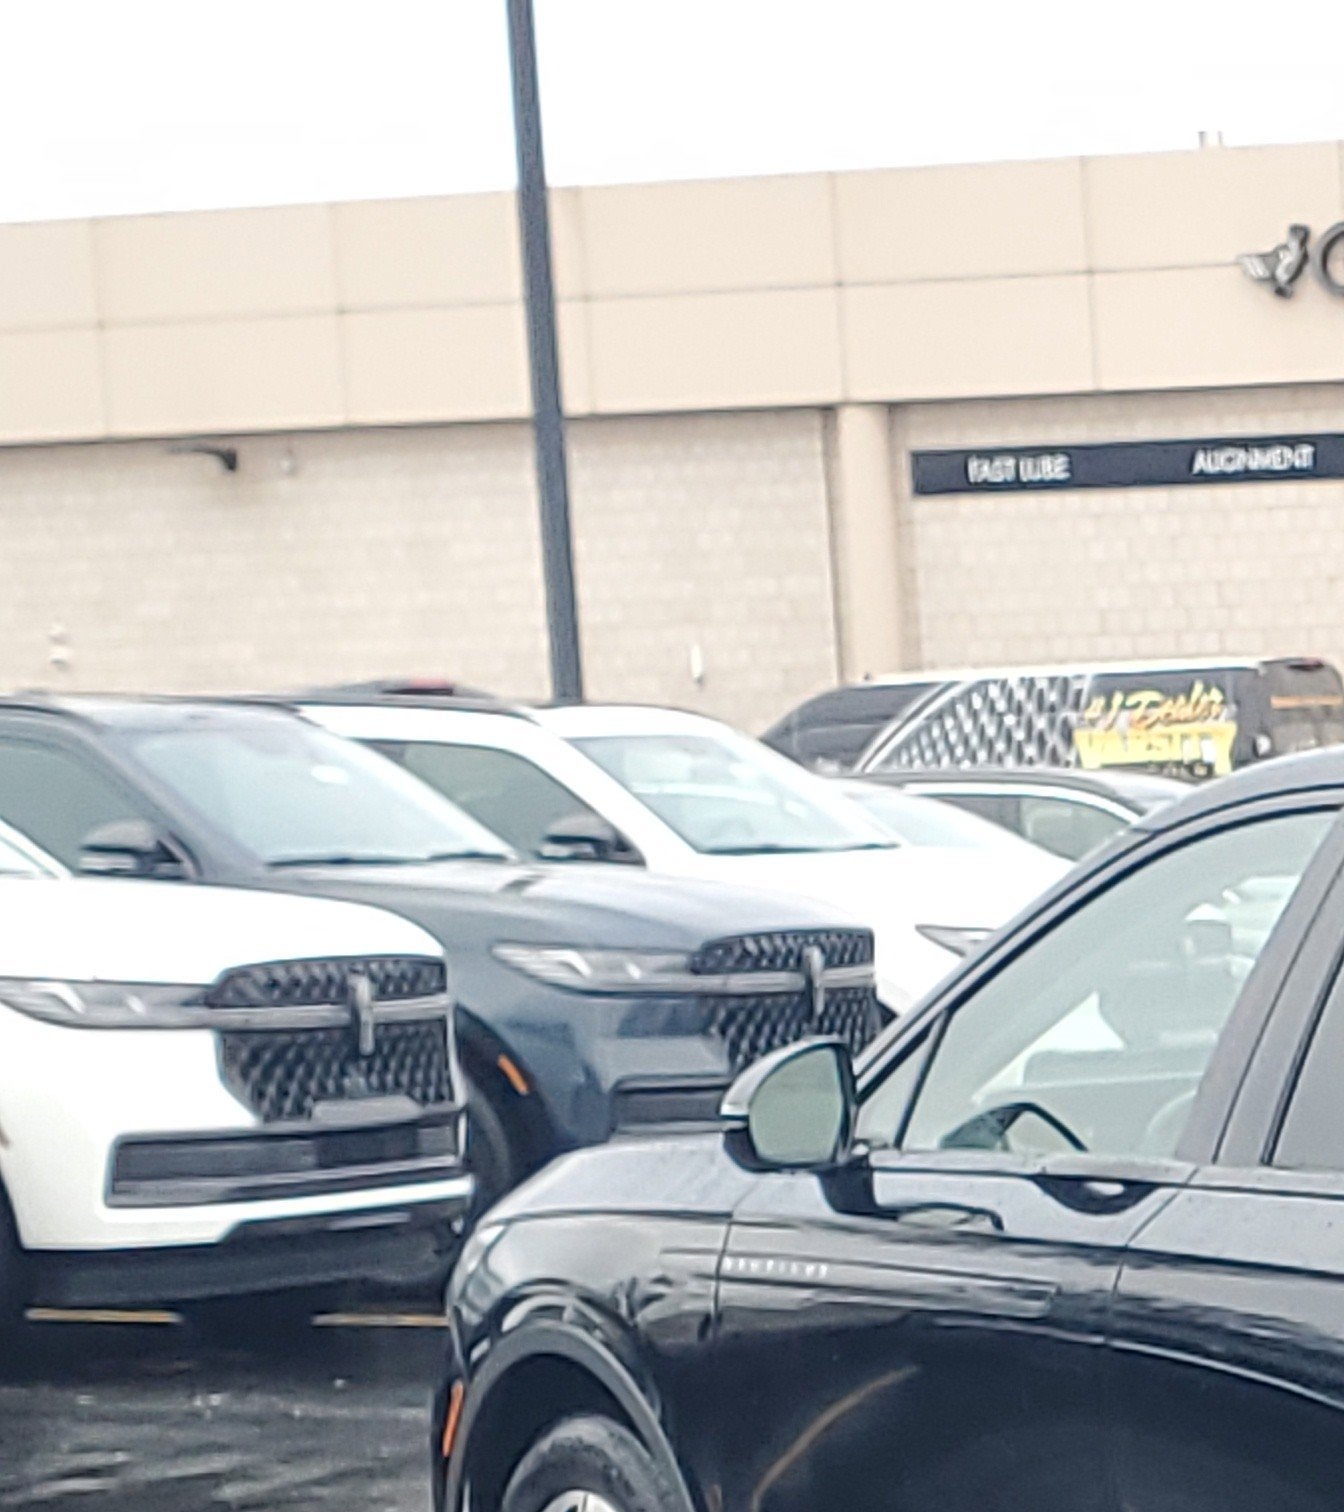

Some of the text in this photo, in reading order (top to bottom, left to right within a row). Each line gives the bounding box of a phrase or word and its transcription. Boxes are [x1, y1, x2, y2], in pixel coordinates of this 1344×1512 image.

[967, 453, 1072, 484] FAST LUBE
[1192, 443, 1315, 475] ALIGNMENT
